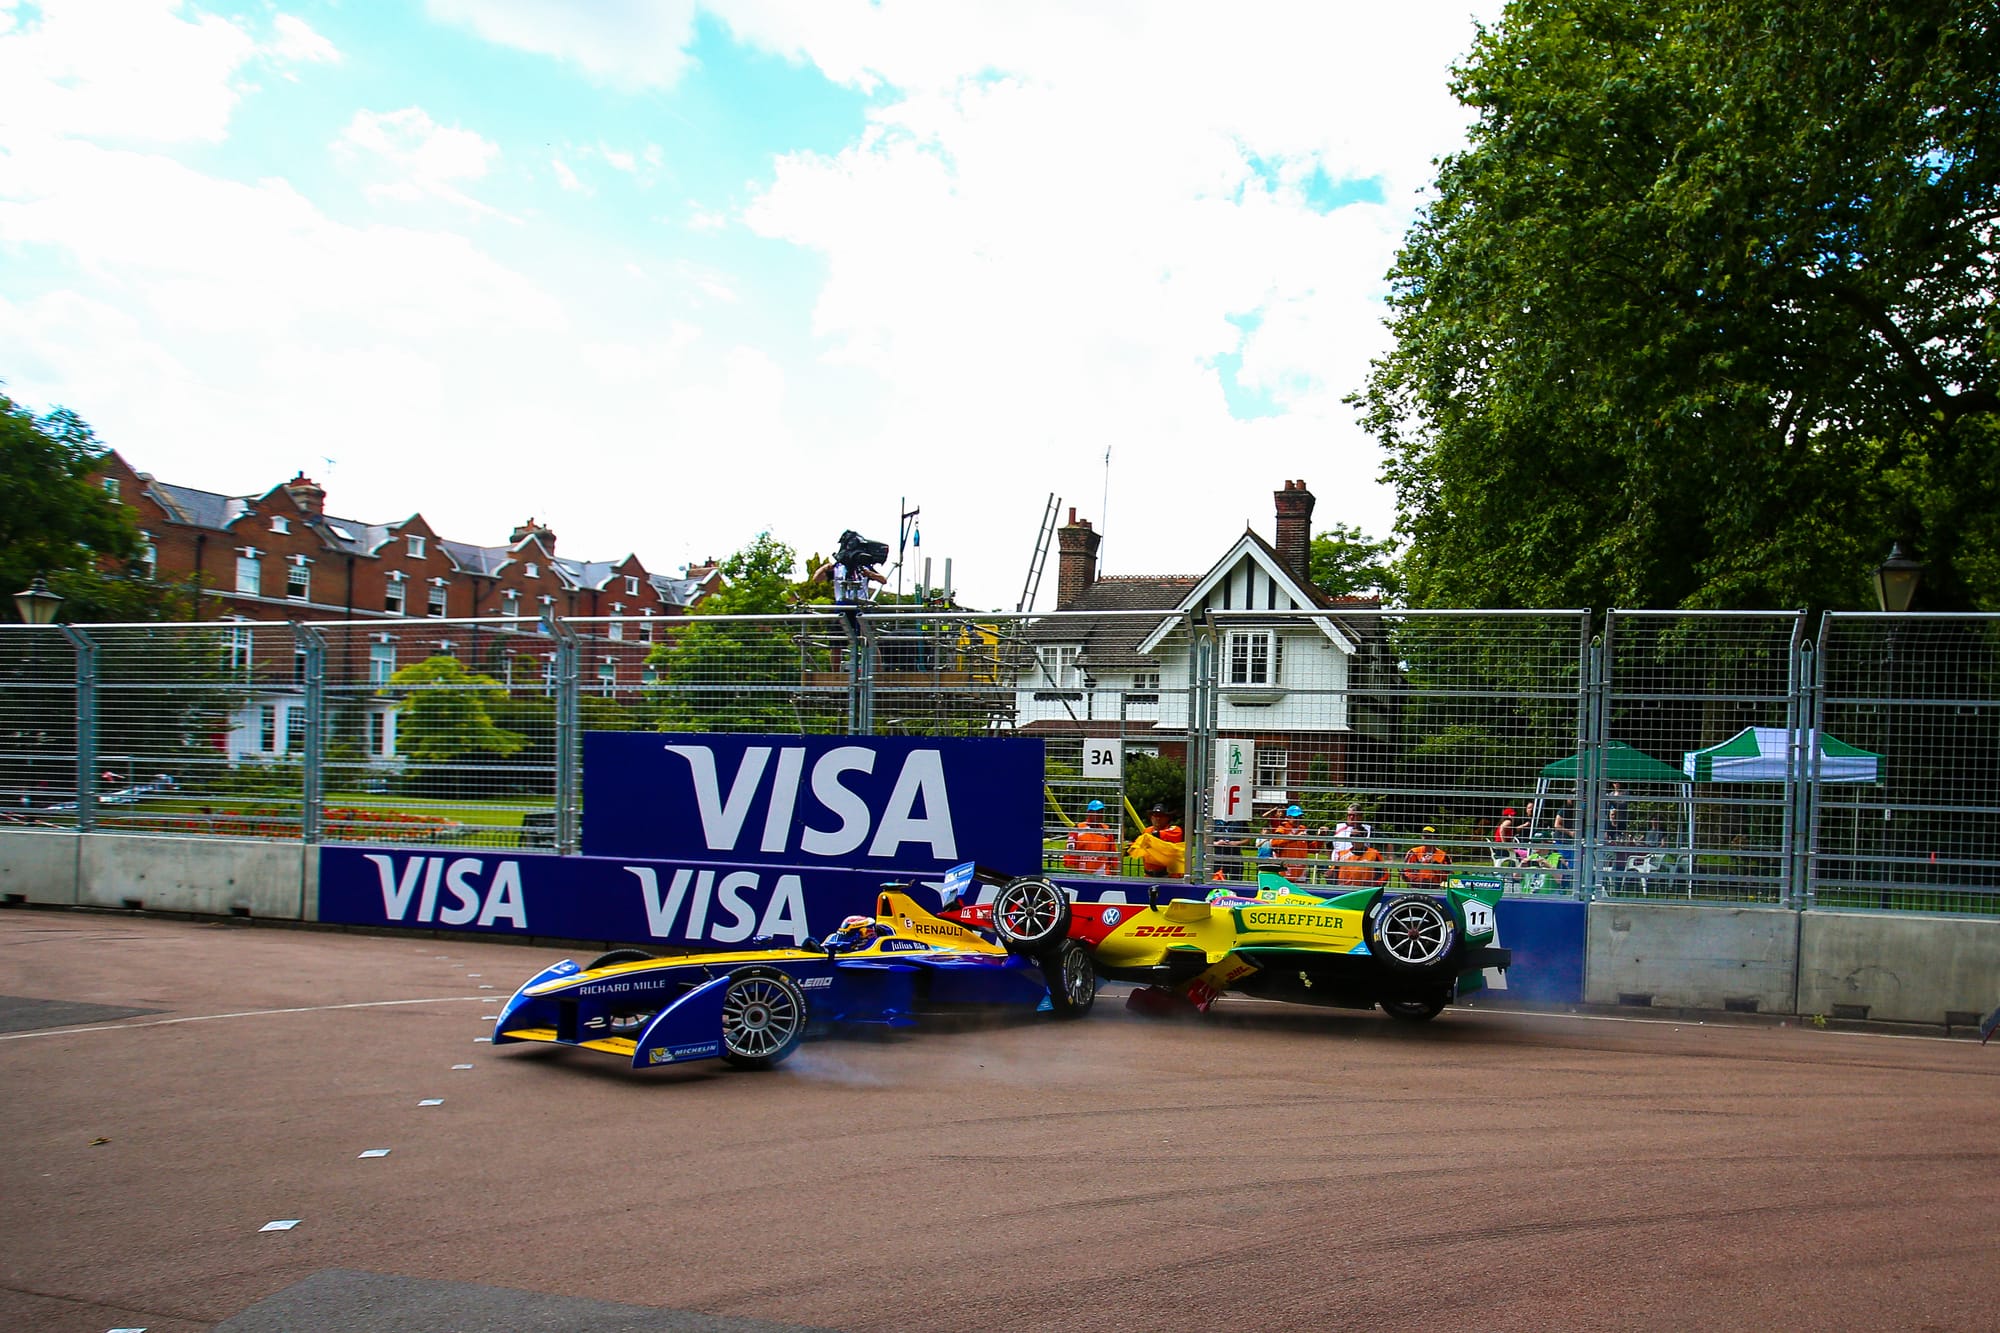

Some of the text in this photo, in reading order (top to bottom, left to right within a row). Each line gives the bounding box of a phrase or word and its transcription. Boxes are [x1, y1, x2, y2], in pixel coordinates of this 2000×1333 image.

[1091, 750, 1114, 765] 3A
[665, 745, 957, 860] VISA
[1228, 785, 1240, 816] F
[364, 854, 527, 929] VISA
[624, 865, 809, 948] VISA
[1250, 912, 1344, 929] SCHAEFFLER
[1470, 911, 1485, 926] 11
[915, 924, 963, 937] RENAULT
[1134, 926, 1187, 937] DHL
[891, 941, 913, 951] Julius
[579, 979, 666, 996] RICHARD MILLE
[797, 976, 834, 988] LEMO
[674, 1044, 717, 1056] MICHELIN
